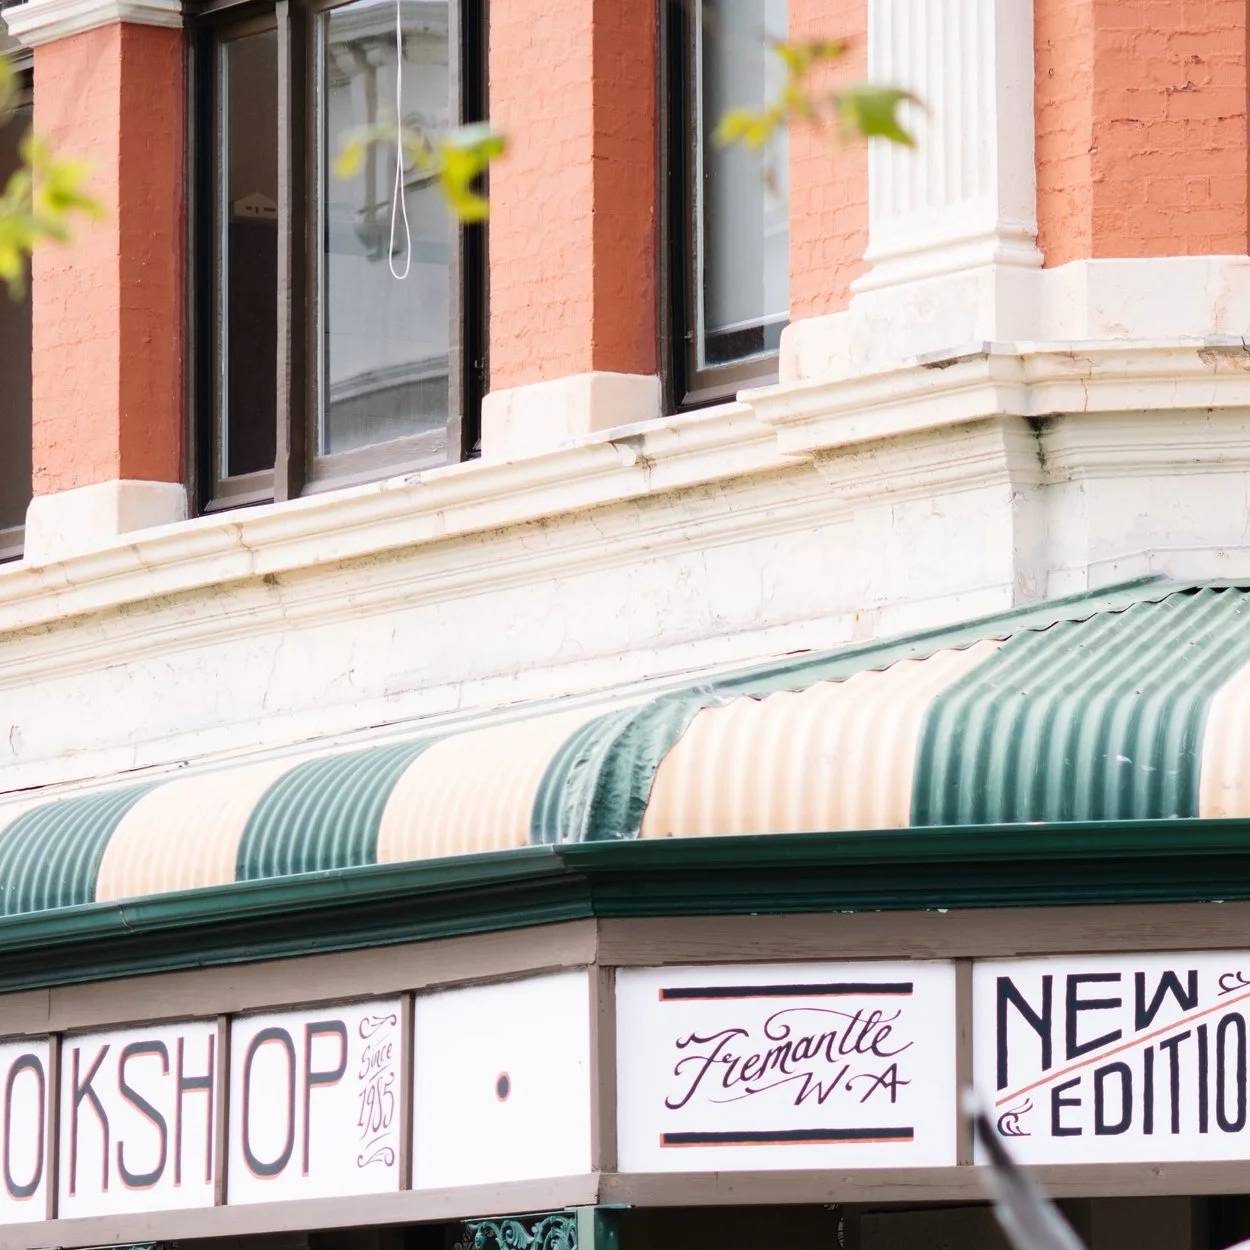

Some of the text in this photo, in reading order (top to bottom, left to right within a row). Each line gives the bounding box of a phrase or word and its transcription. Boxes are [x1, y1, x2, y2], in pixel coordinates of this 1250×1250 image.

[358, 1042, 393, 1081] Since
[664, 1007, 914, 1111] Fremantle
[997, 969, 1198, 1092] NEW
[356, 1071, 395, 1140] 1985
